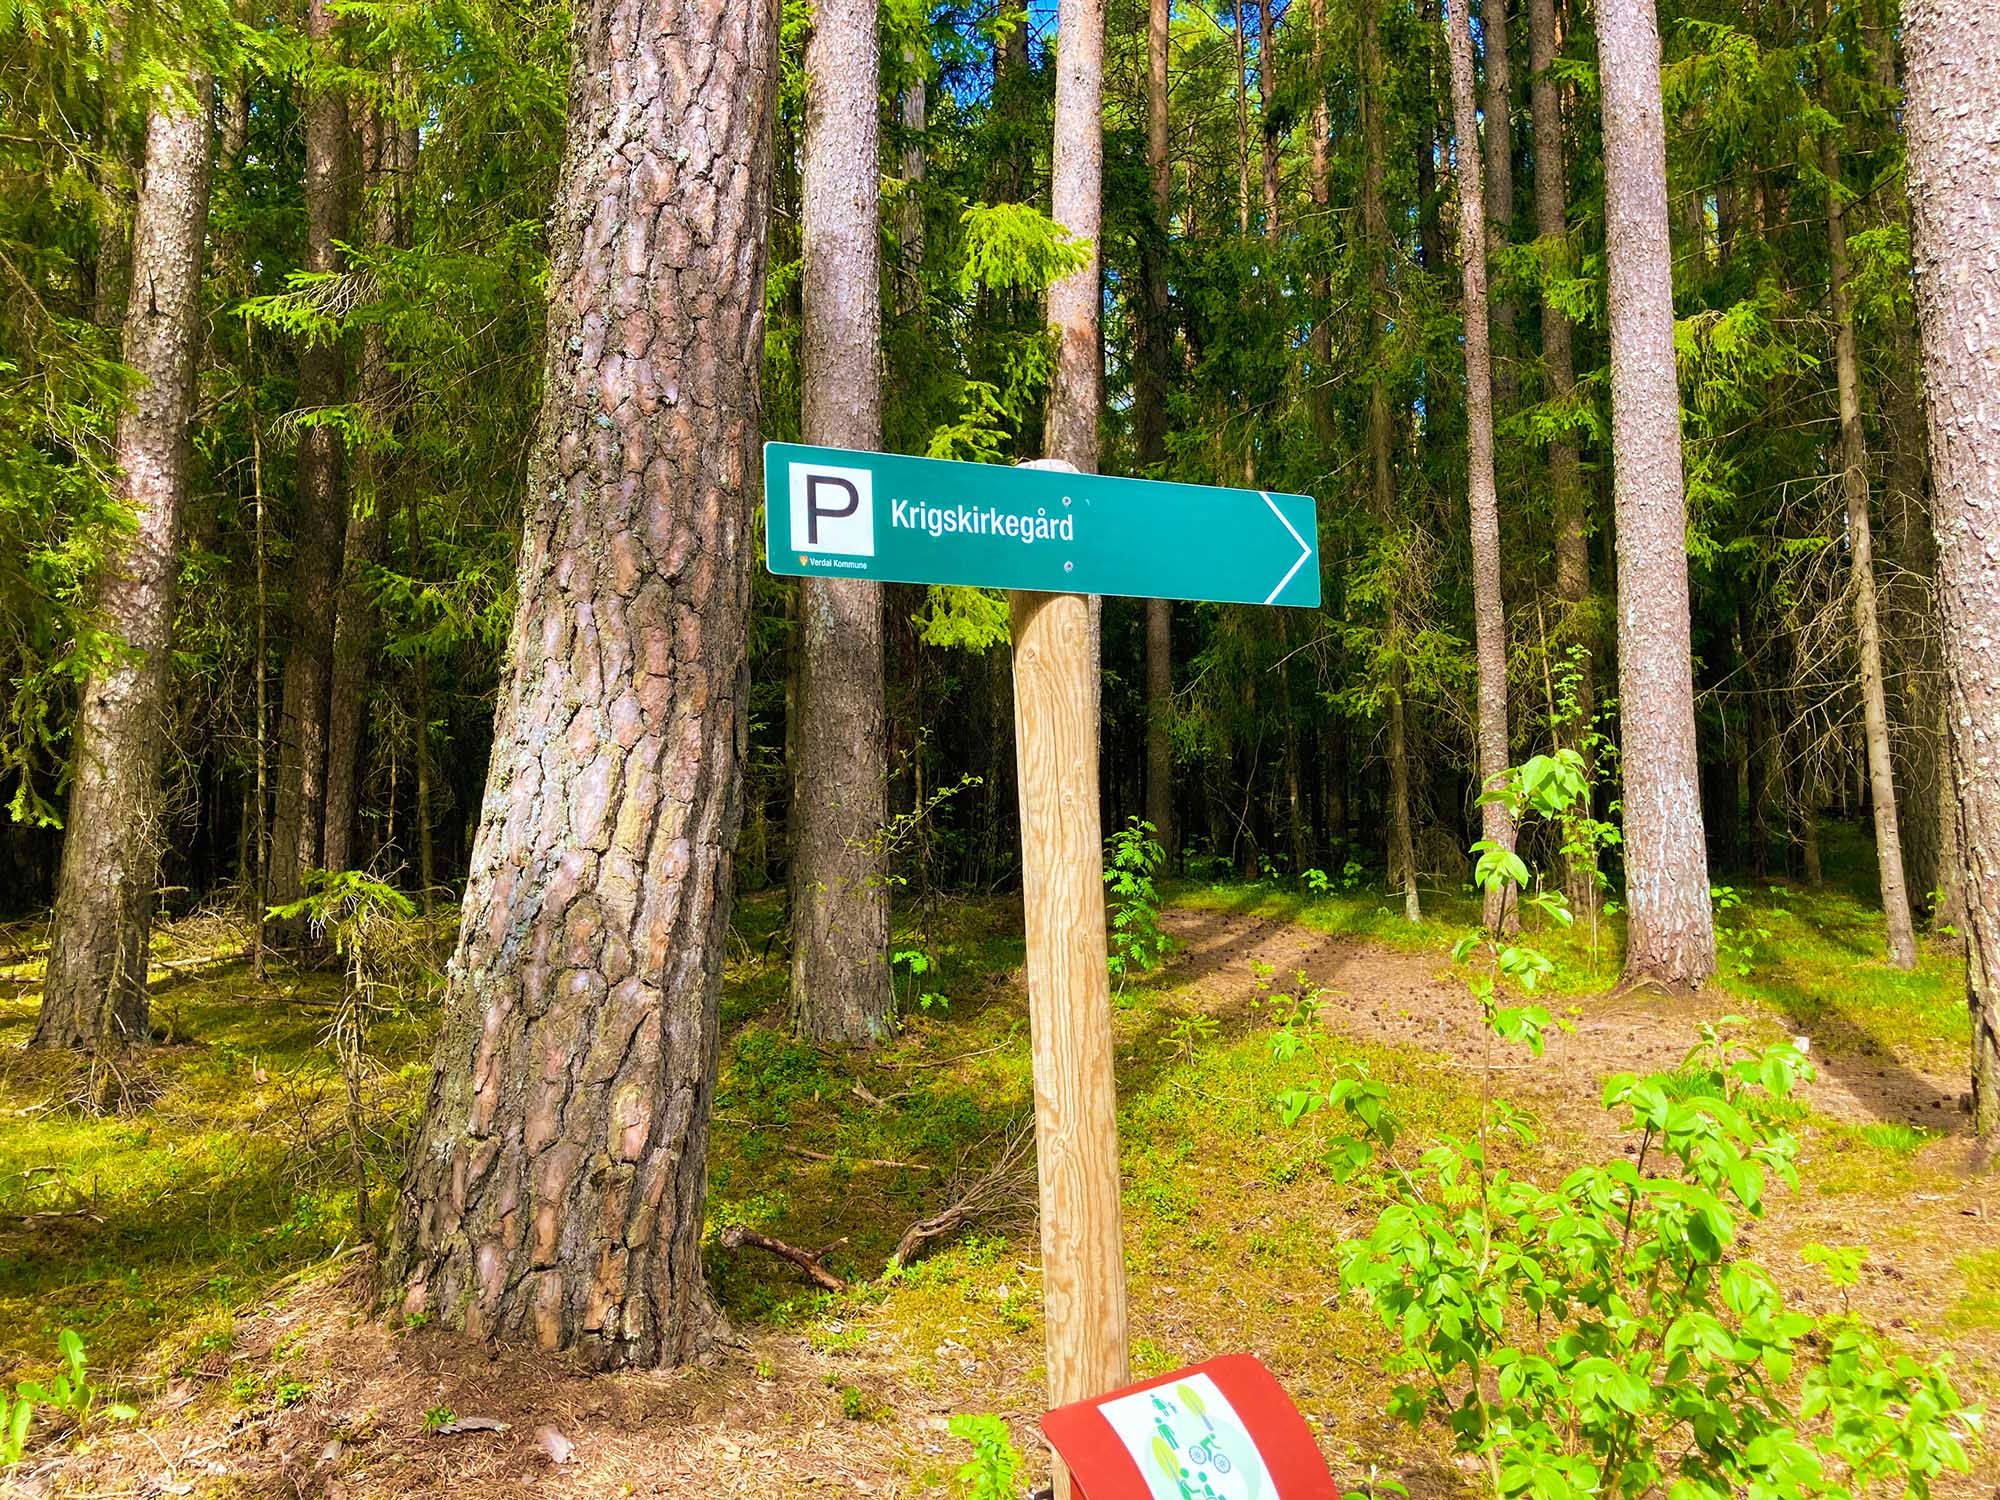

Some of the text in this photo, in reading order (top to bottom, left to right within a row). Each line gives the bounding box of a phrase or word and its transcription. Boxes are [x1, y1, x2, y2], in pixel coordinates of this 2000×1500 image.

[806, 474, 859, 544] P
[891, 499, 1074, 544] Krigskirkegård
[809, 557, 867, 569] Verdal Kommune
